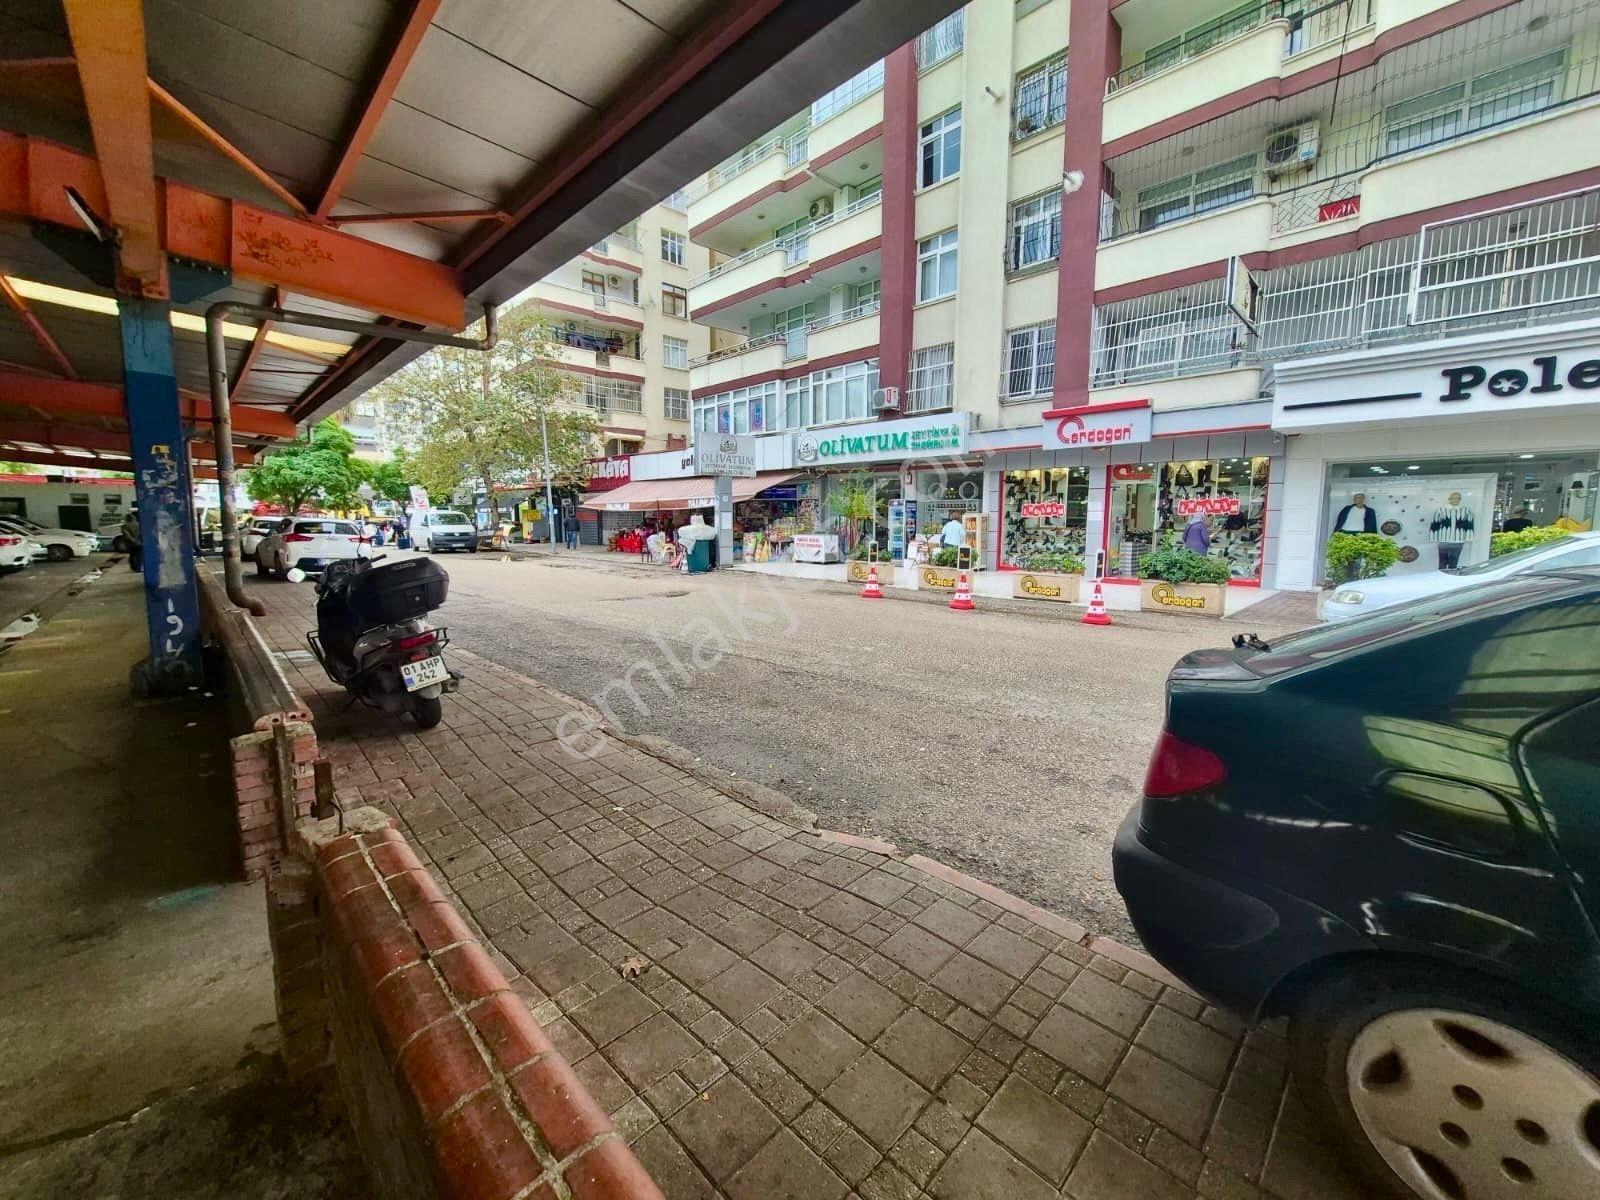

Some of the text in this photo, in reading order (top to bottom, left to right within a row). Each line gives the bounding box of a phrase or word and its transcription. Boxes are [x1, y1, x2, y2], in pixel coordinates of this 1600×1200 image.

[819, 431, 909, 457] OLİVATUM
[701, 453, 754, 466] OLIVATUM
[403, 657, 440, 676] 01 AHP
[416, 670, 437, 682] 242
